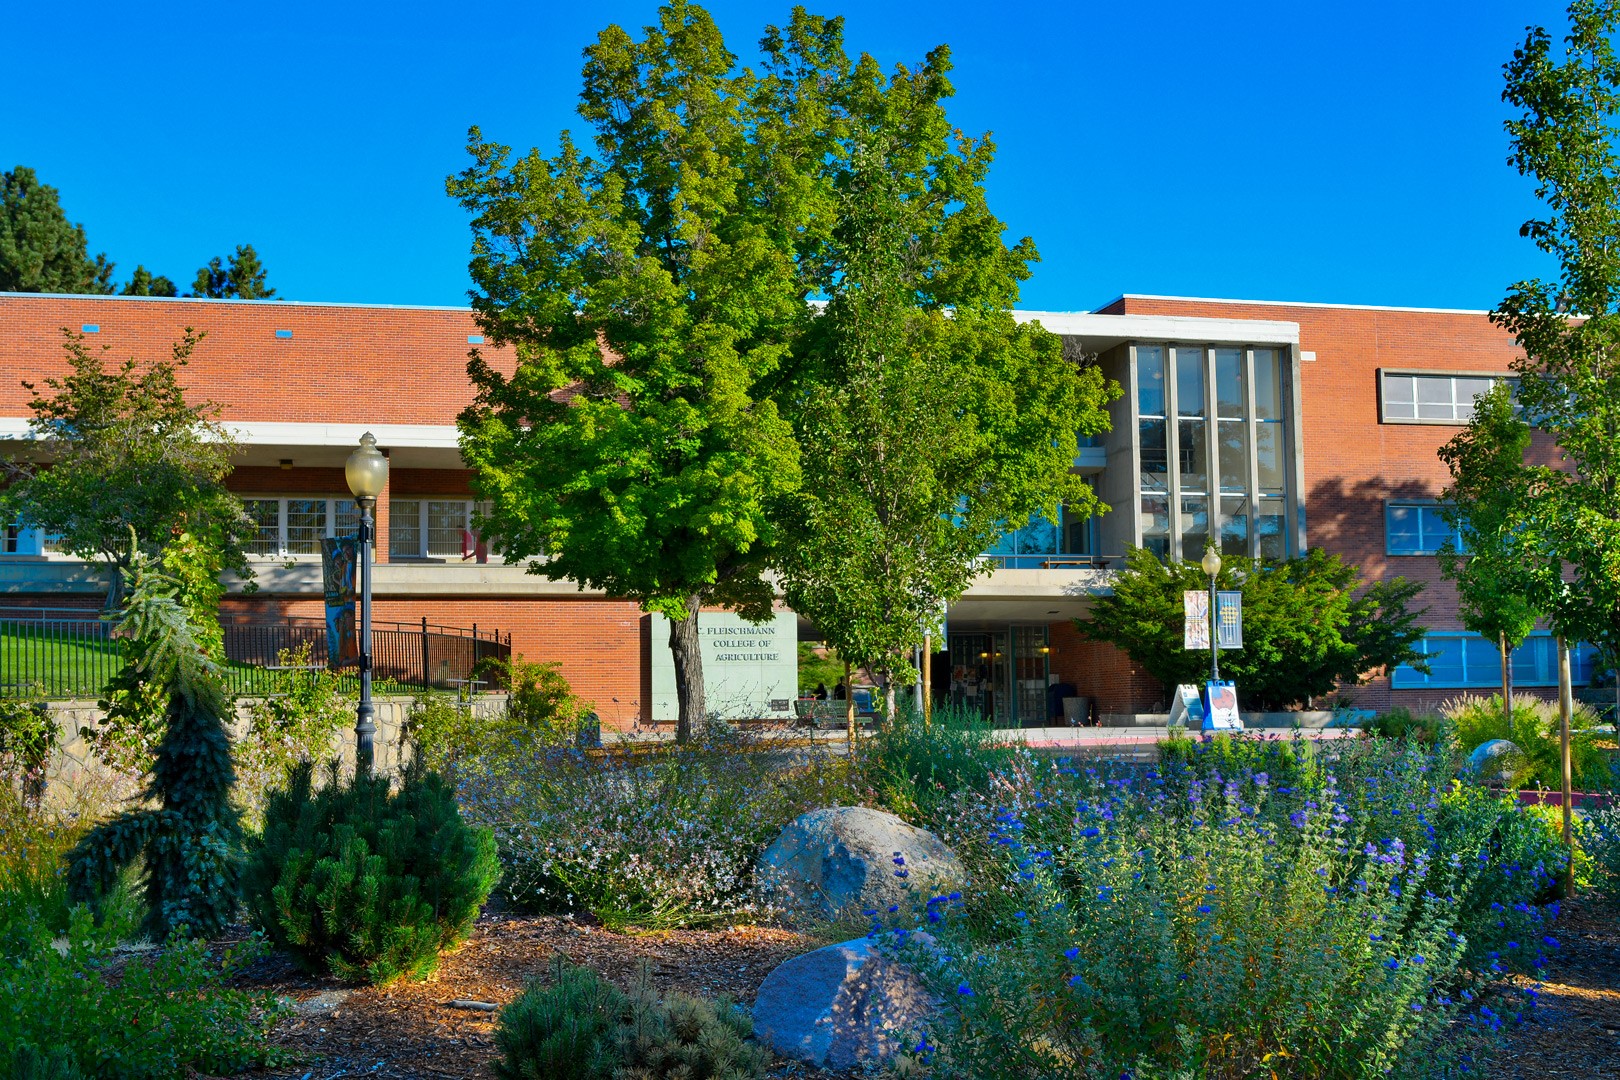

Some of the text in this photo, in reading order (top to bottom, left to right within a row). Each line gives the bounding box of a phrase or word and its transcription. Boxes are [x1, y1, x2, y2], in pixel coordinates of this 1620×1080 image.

[707, 627, 775, 635] FLEISCHMANN
[713, 640, 771, 648] COLLEGE OF
[715, 653, 779, 661] AGRICULTURE
